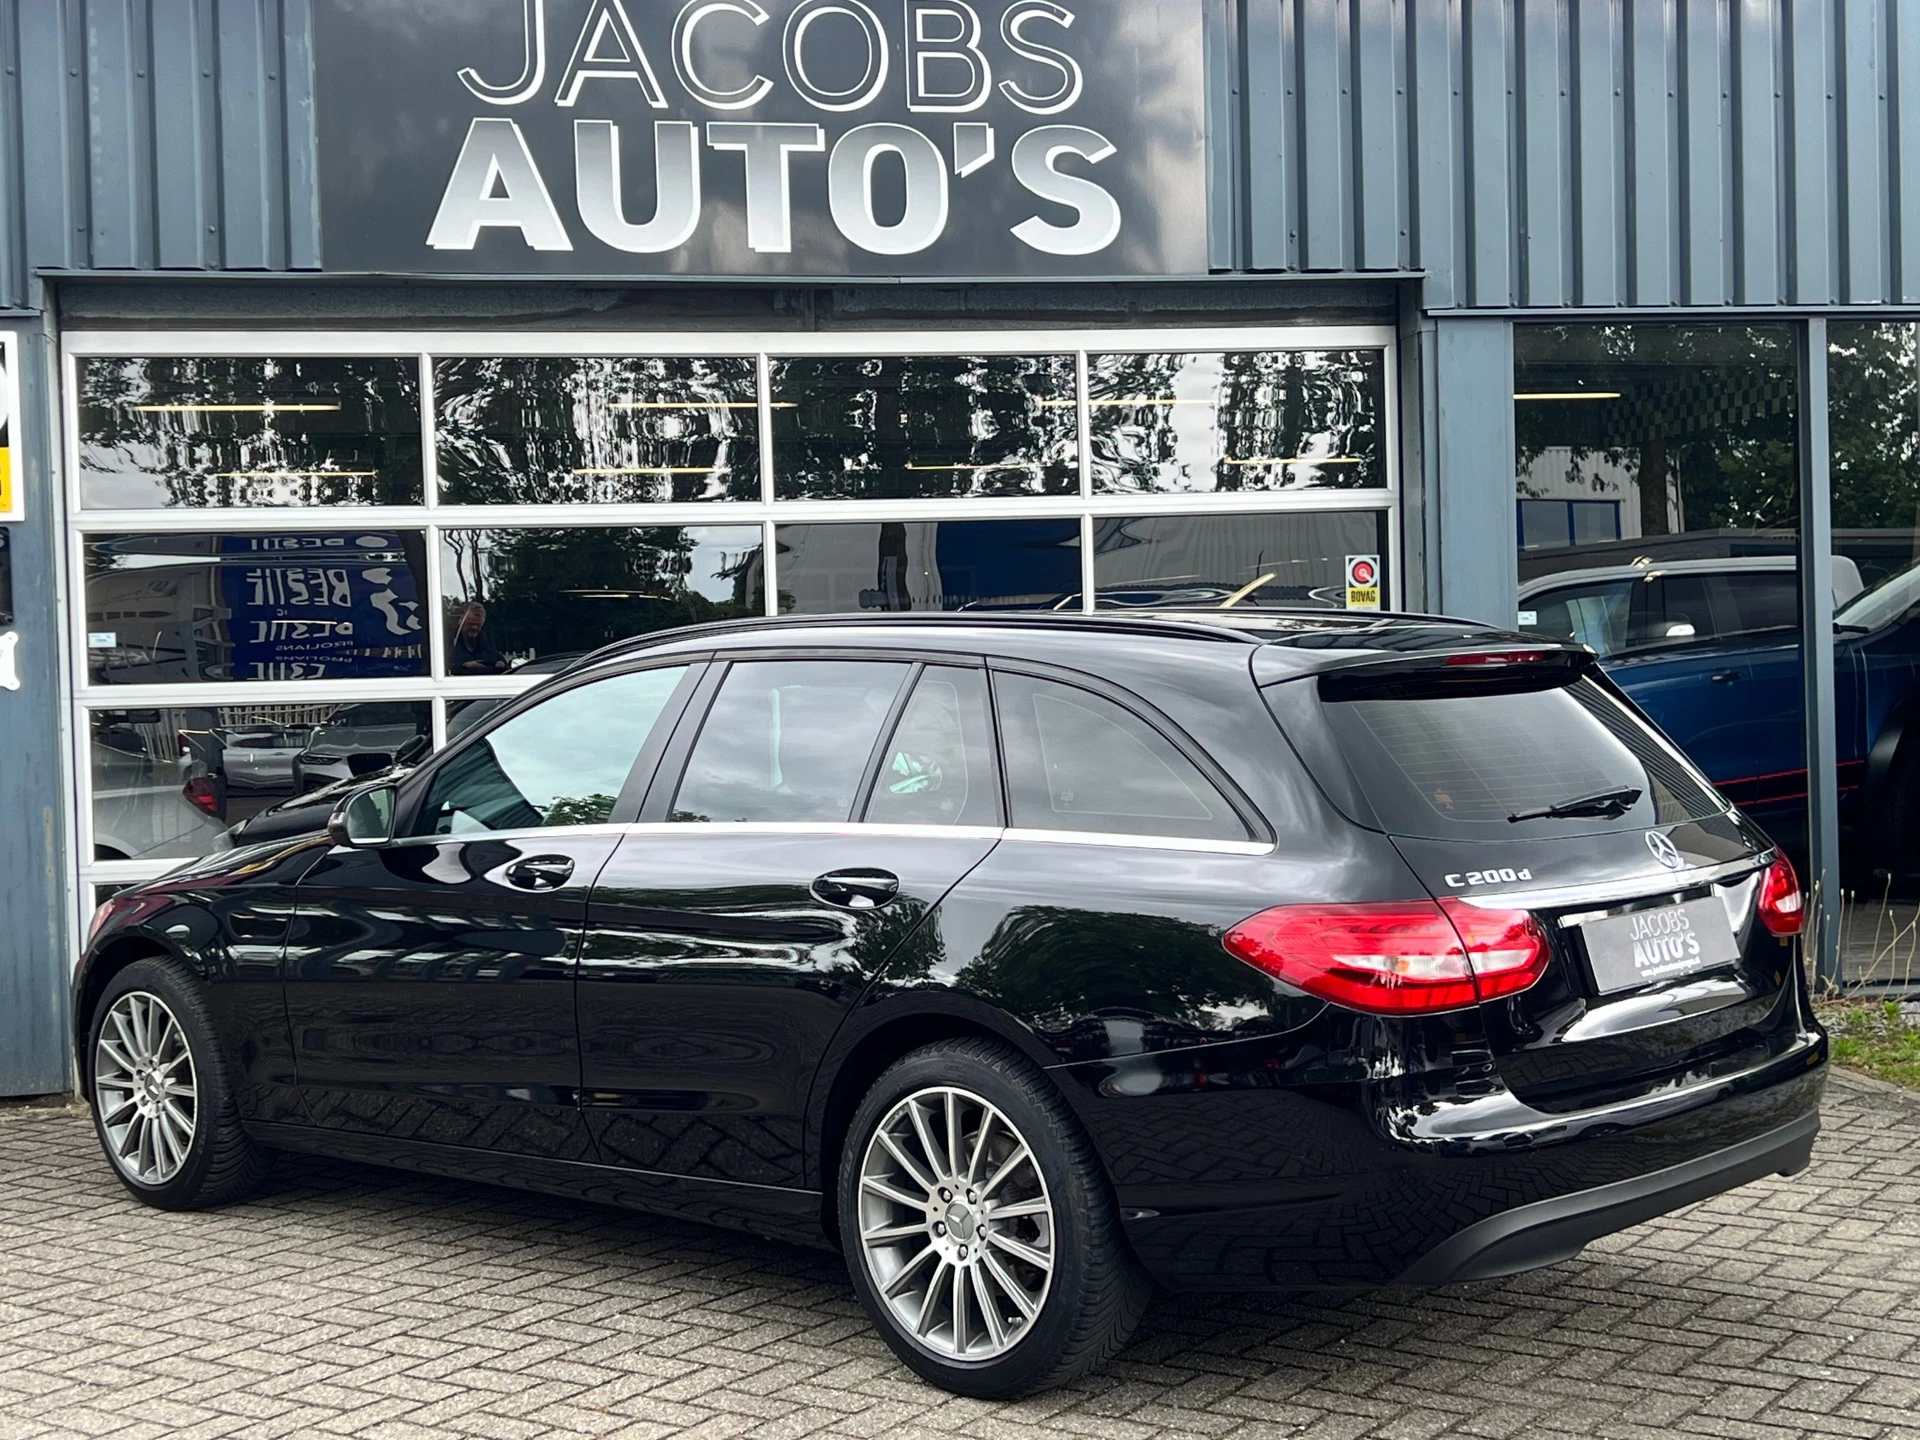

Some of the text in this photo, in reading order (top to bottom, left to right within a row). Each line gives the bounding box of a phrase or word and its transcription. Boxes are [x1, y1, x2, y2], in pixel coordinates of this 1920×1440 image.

[457, 0, 1083, 114] JACOBS
[425, 117, 1121, 255] AUTO'S
[1350, 590, 1376, 603] BOVAG
[1629, 908, 1690, 941] JACOBS
[1632, 929, 1701, 969] AUTO'S
